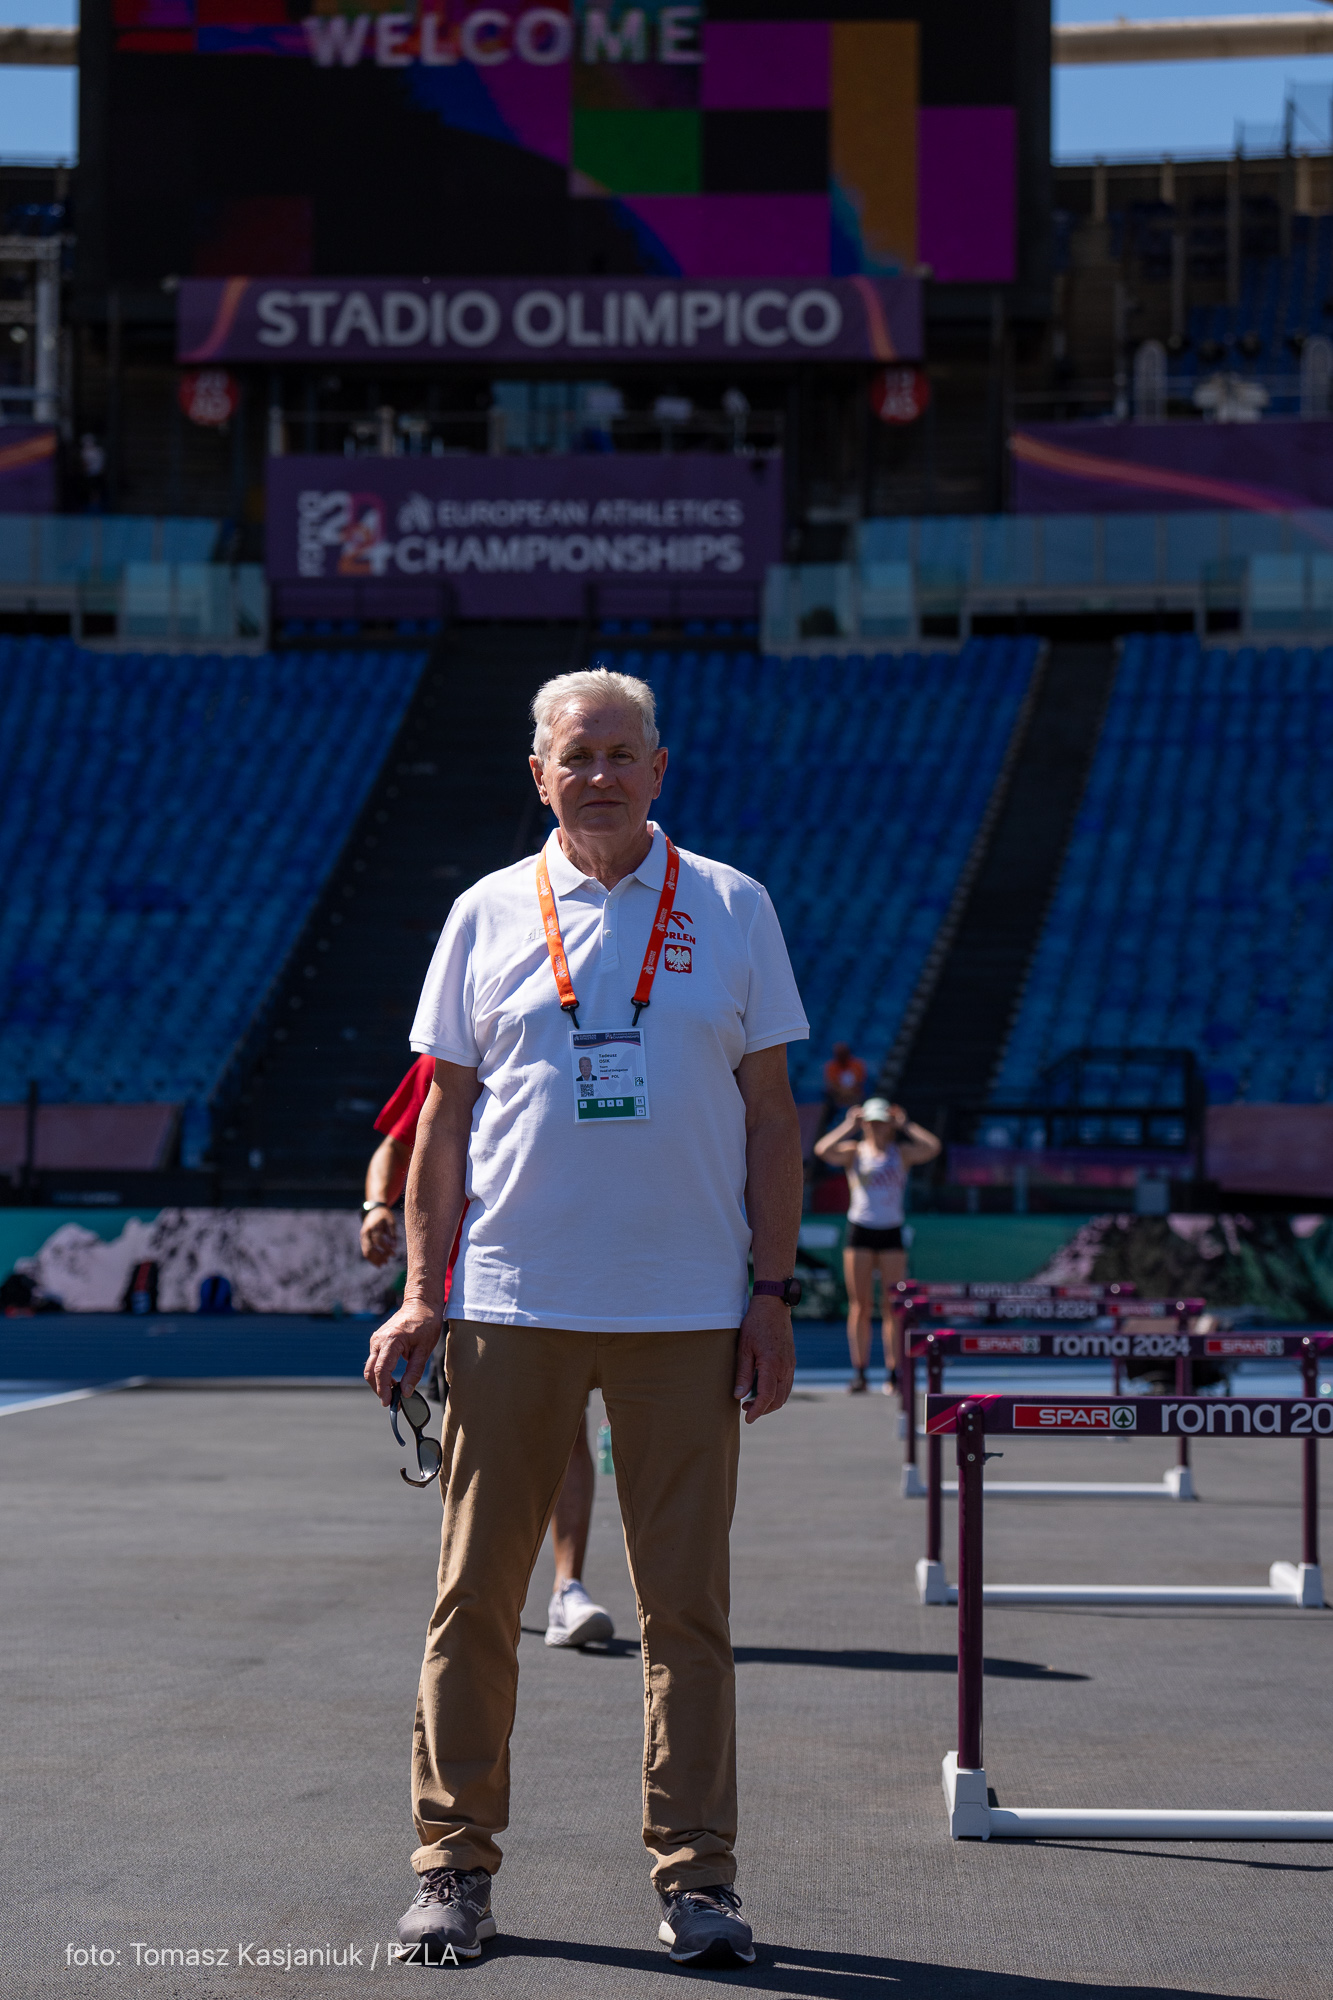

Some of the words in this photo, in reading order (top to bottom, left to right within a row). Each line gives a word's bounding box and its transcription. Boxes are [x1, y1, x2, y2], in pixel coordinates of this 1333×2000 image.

[303, 7, 706, 67] WELCOME
[257, 290, 501, 348] STADIO
[513, 289, 842, 348] OLIMPICO
[437, 501, 583, 527] EUROPEAN
[591, 500, 744, 527] ATHLETICS
[397, 534, 744, 574] CHAMPIONSHIPS
[977, 1338, 1023, 1351] SPAR
[1052, 1337, 1129, 1356] roma
[1132, 1335, 1190, 1357] 2024
[1220, 1340, 1266, 1353] SPAR
[1039, 1409, 1108, 1425] SPAR
[1161, 1404, 1281, 1433] roma
